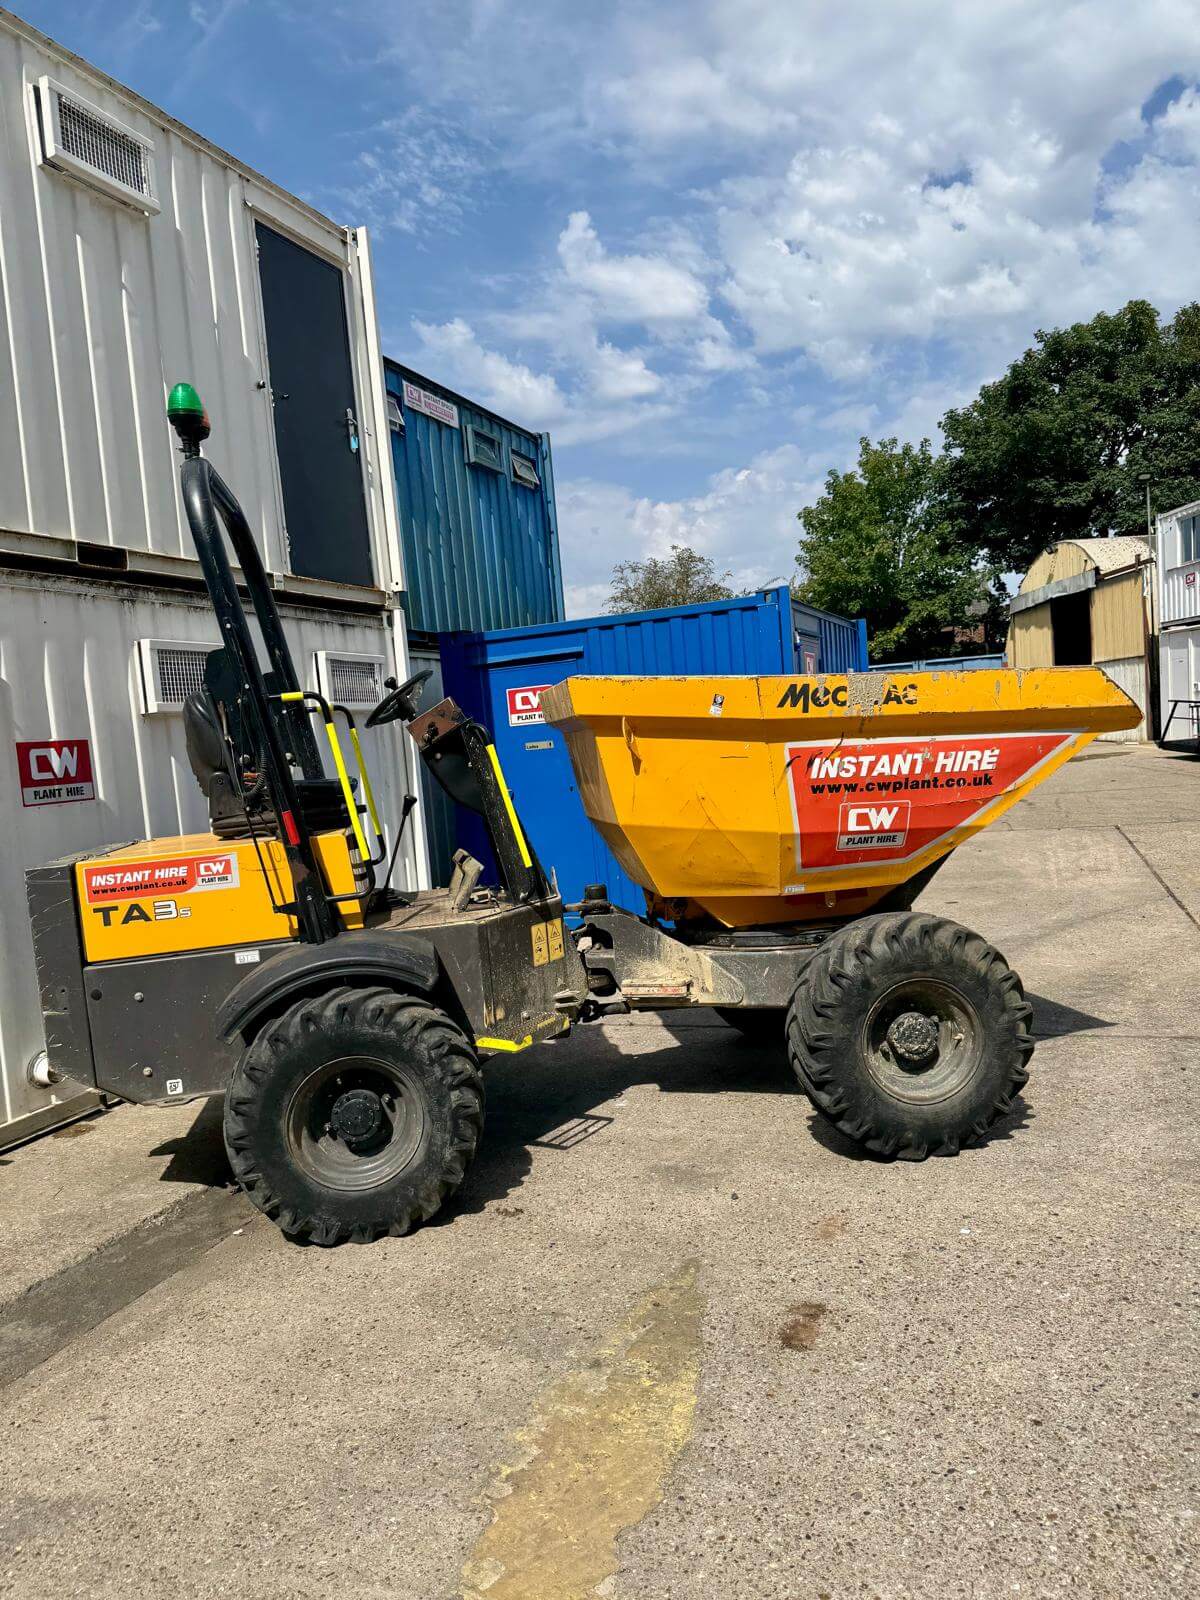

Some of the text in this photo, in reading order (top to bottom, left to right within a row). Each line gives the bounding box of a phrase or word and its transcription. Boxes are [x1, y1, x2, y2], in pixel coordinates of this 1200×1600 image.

[29, 745, 78, 780] CW
[810, 750, 1000, 779] INSTANT HIRE
[33, 786, 85, 800] PLANT HIRE
[810, 773, 993, 794] www.cwplant.co.uk
[847, 806, 899, 832] CW
[846, 834, 898, 846] PLANT HIRE
[92, 866, 188, 886] INSTANT HIRE
[200, 861, 225, 875] CW
[92, 878, 187, 895] www.cwplant.co.uk
